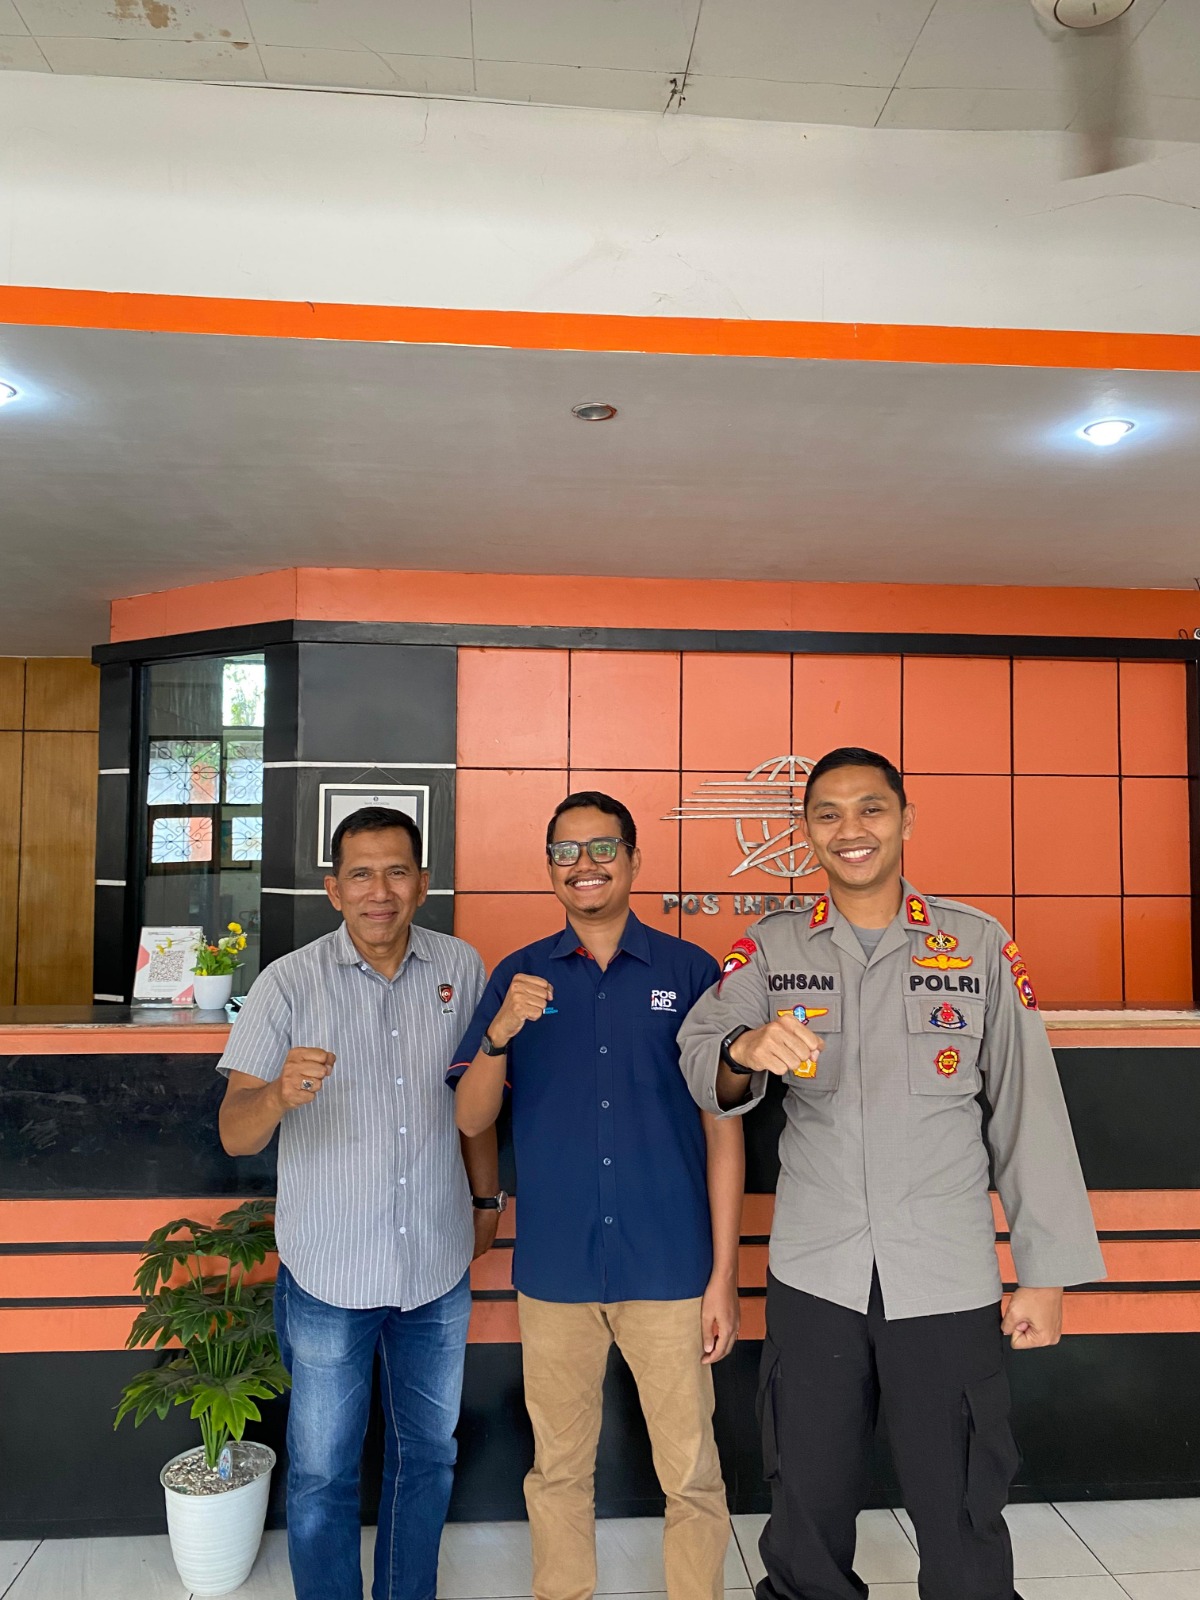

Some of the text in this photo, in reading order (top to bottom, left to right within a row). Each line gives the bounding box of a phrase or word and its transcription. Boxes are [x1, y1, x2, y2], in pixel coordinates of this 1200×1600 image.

[662, 894, 720, 915] POS
[768, 973, 834, 992] ICHSAN
[909, 974, 980, 994] POLRI
[651, 989, 677, 1000] POS
[651, 996, 672, 1008] IND
